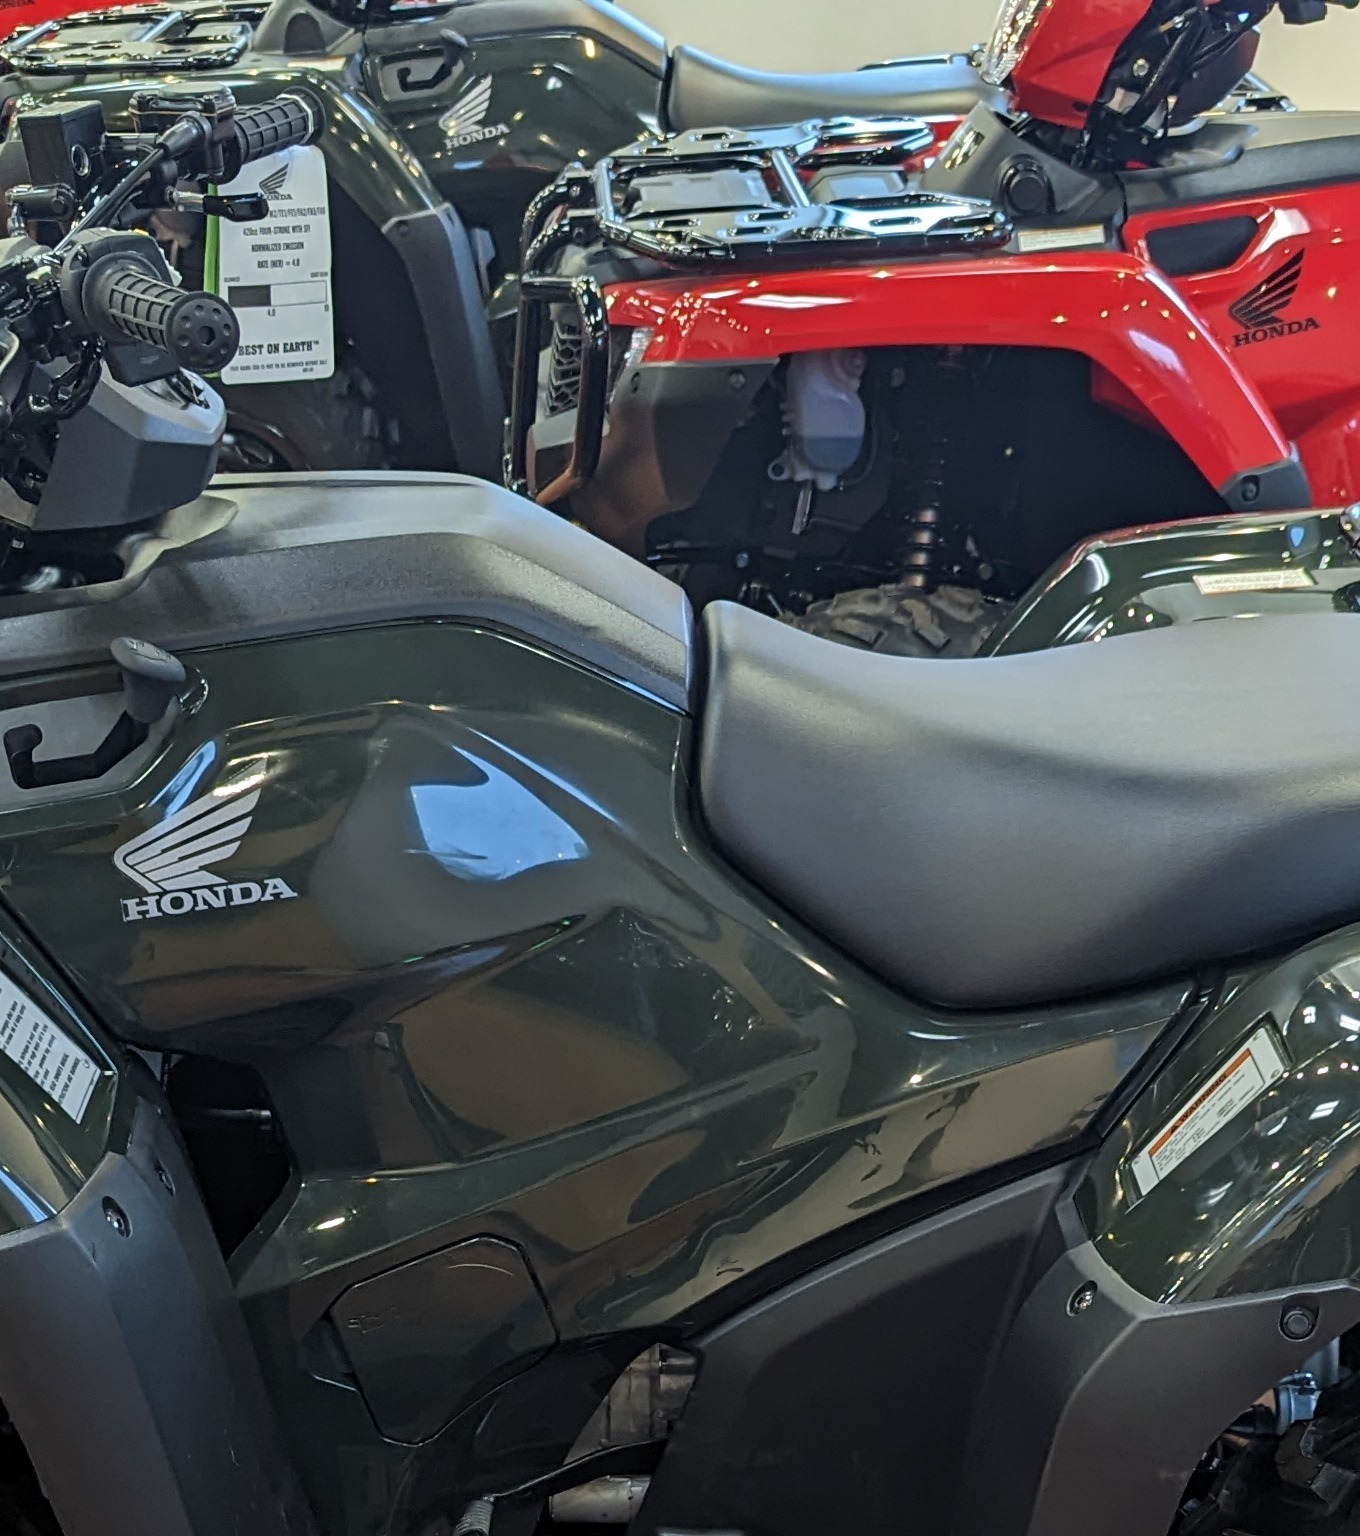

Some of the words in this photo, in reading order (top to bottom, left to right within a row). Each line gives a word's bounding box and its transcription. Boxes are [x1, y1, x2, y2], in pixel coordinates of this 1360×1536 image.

[443, 122, 510, 149] HONDA
[262, 193, 293, 201] ONDA
[1232, 317, 1321, 347] HONDA
[238, 344, 264, 356] BEST
[267, 344, 280, 354] ON
[121, 877, 298, 921] HONDA
